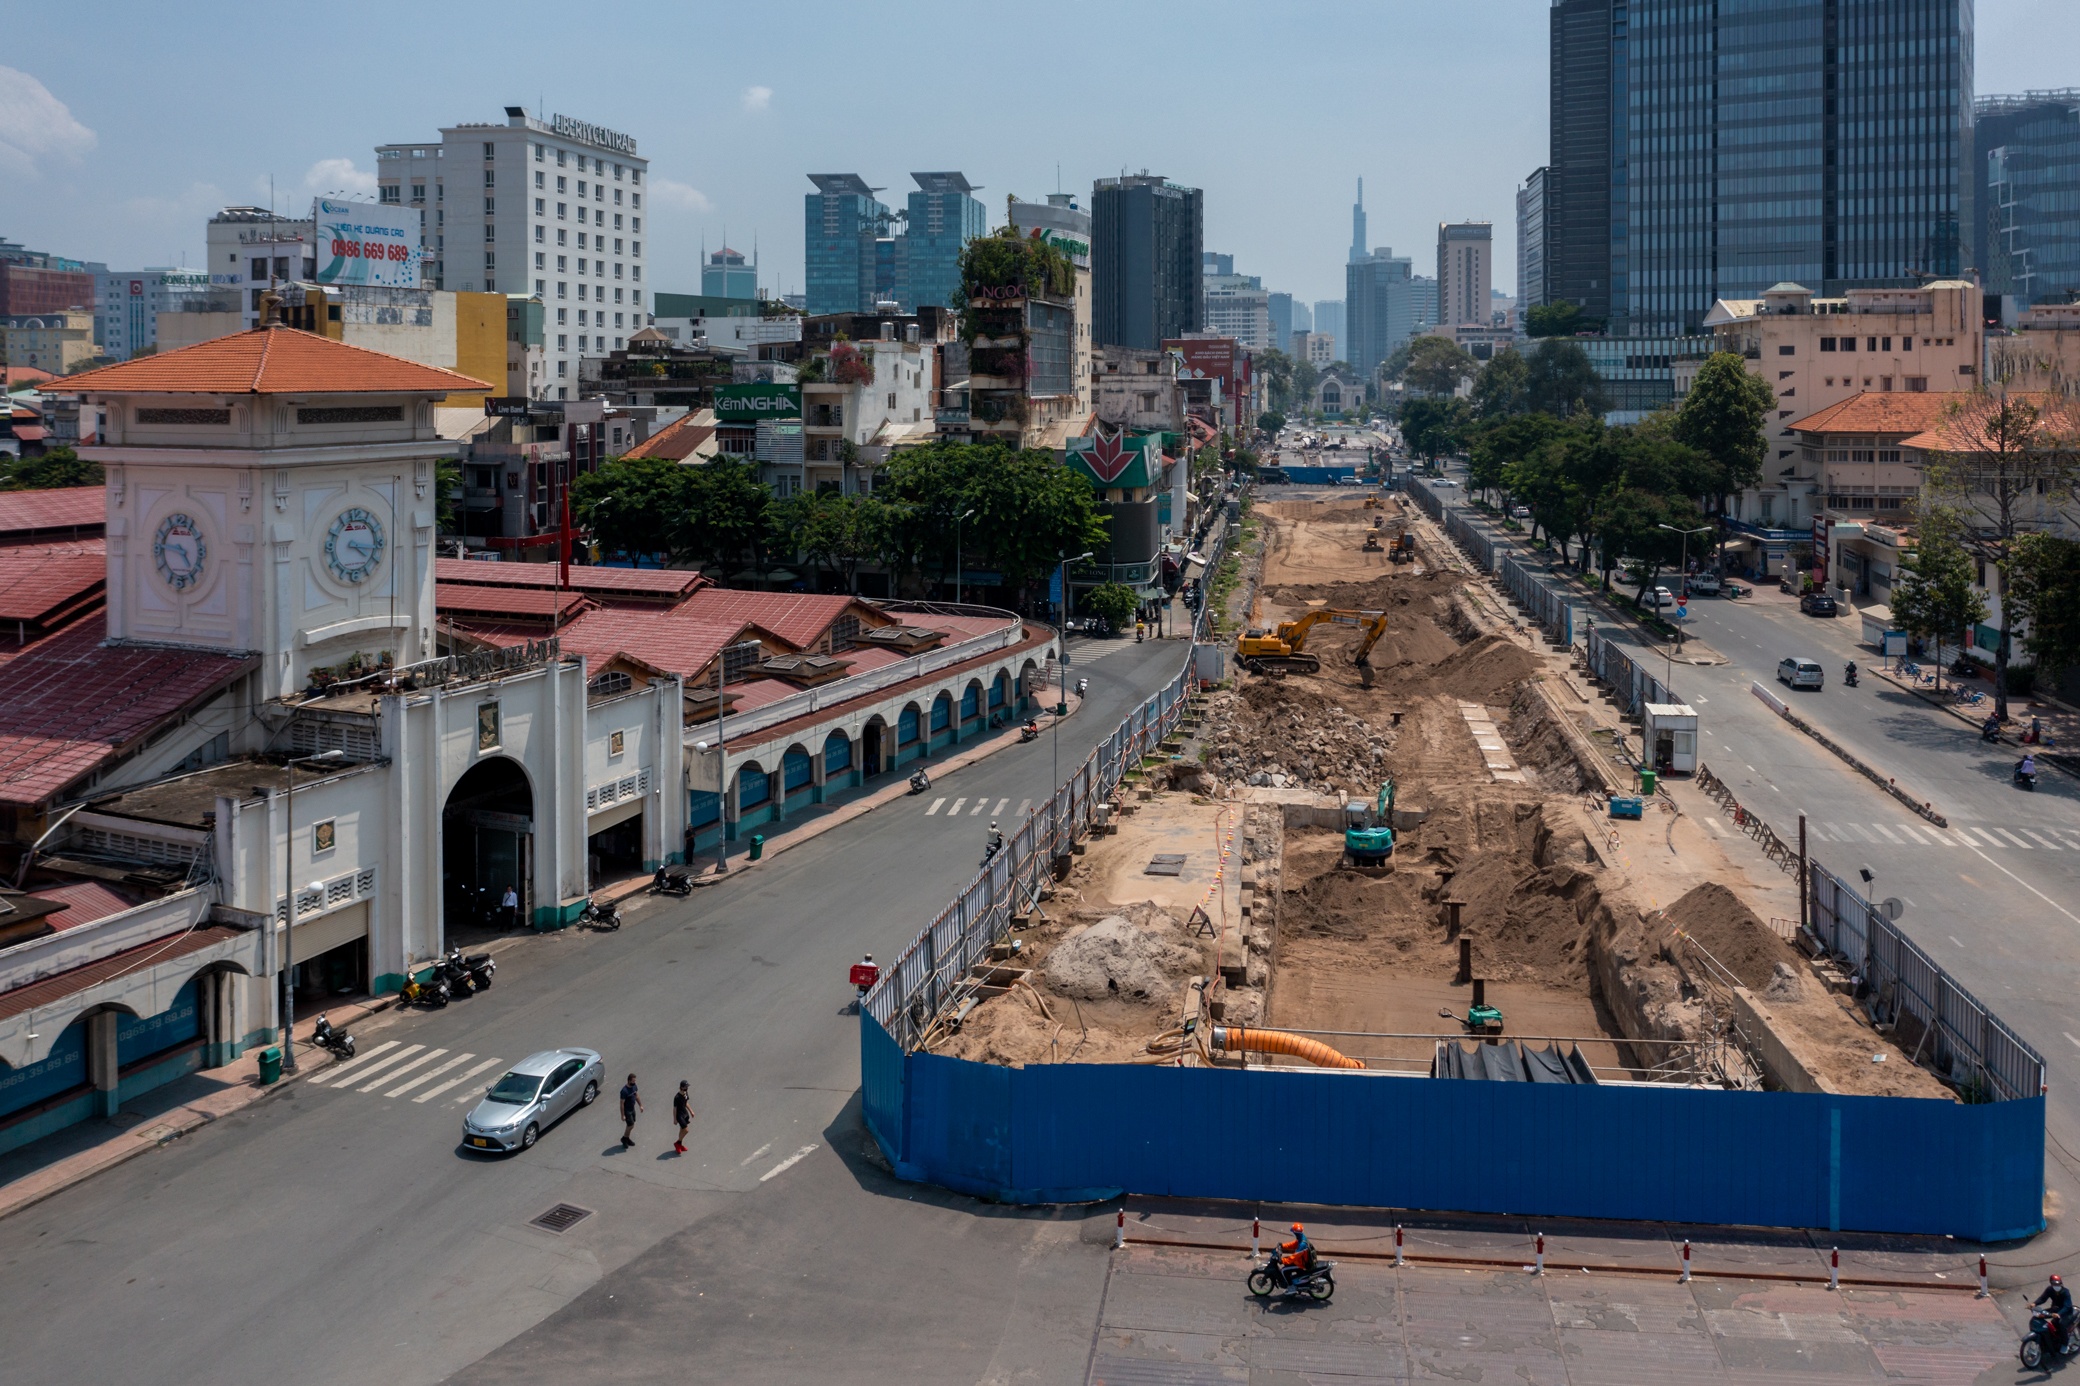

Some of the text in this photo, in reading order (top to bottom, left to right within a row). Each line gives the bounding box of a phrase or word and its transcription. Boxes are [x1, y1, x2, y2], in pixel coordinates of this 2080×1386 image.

[332, 239, 361, 258] 0986
[363, 242, 385, 260] 669
[388, 244, 409, 262] 689
